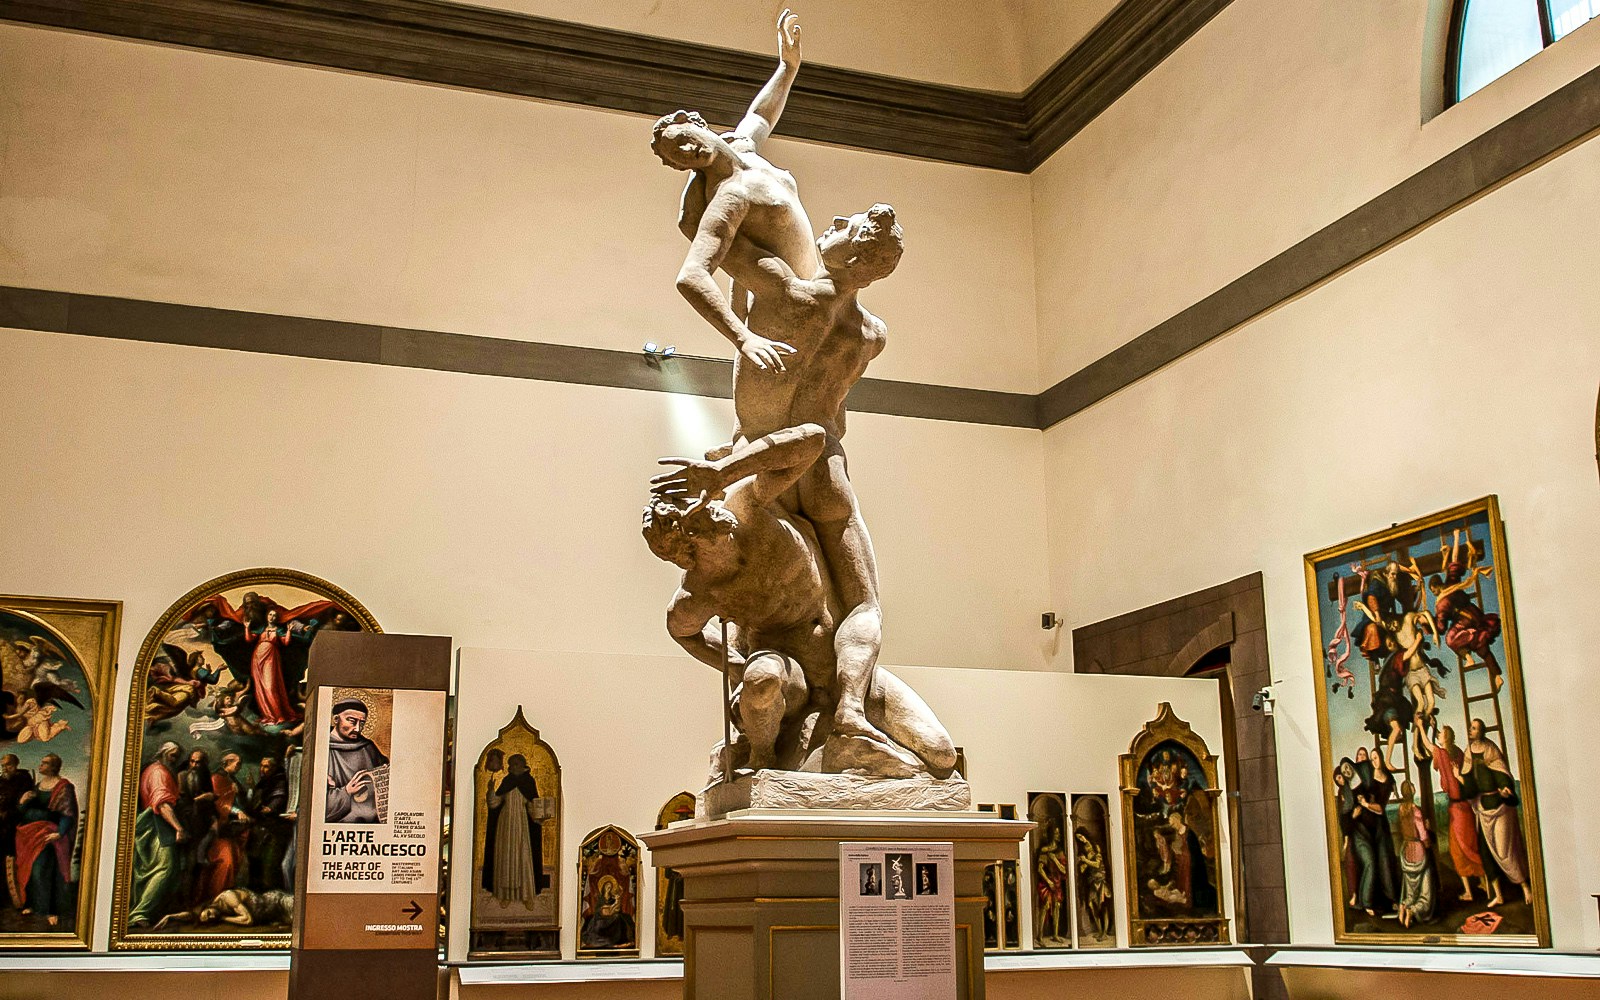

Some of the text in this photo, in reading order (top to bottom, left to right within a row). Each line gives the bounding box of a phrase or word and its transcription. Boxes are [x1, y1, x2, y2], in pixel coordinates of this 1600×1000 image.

[323, 830, 374, 842] L'ARTE
[322, 844, 426, 856] DI FRANCESCO
[322, 862, 381, 870] THE ART OF
[322, 871, 384, 880] FRANCESCO
